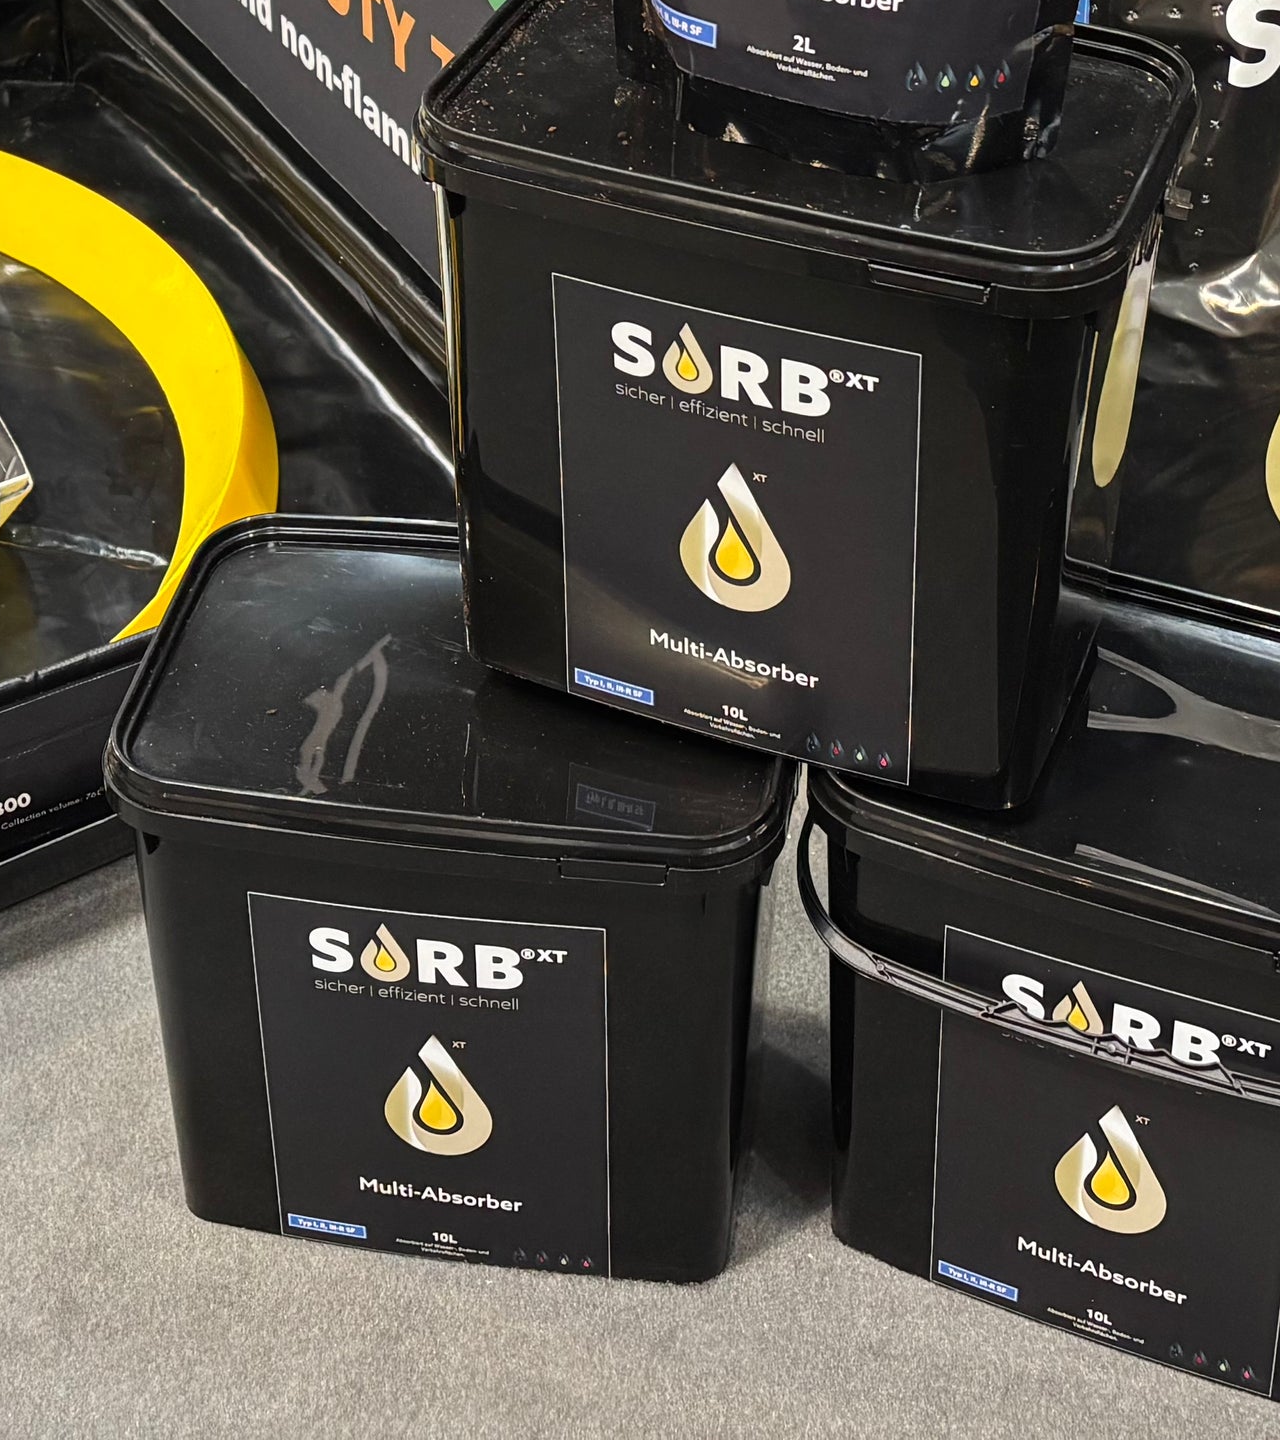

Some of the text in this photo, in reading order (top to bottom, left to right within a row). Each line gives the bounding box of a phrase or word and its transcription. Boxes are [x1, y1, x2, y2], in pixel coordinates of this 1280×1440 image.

[792, 34, 816, 55] 2L
[852, 67, 869, 79] und
[615, 382, 825, 444] sicher effizient schnell
[752, 472, 768, 484] XT
[649, 627, 820, 689] Multi-Absorber
[584, 675, 599, 687] Typ
[721, 704, 749, 722] 10L
[0, 809, 47, 831] Collection
[48, 797, 83, 813] volume:
[314, 977, 519, 1011] sicher effizient schnell
[451, 1040, 467, 1050] XT
[1134, 1114, 1152, 1126] XT
[359, 1175, 523, 1212] Multi-Absorber
[431, 1231, 458, 1245] 10L
[1016, 1234, 1188, 1306] Multi-Absorber
[1085, 1307, 1113, 1327] 10L
